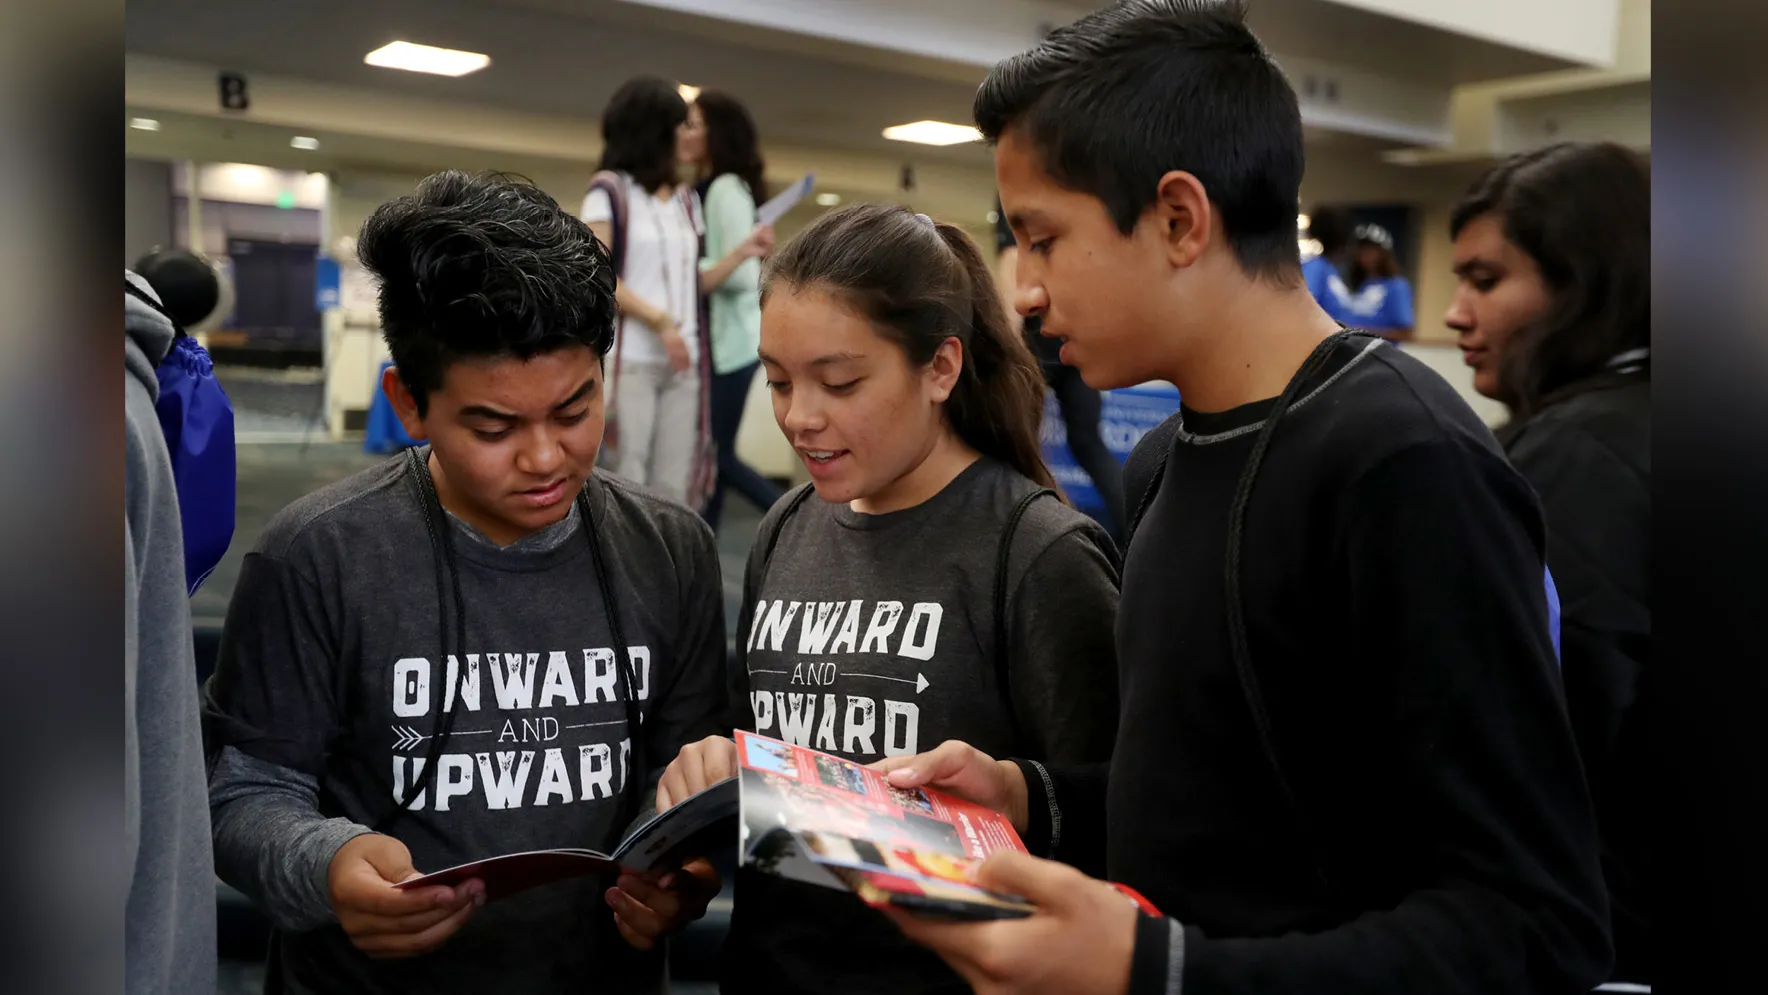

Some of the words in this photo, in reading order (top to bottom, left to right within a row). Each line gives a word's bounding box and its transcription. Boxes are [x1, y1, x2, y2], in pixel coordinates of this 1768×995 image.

[393, 646, 650, 717] ONWARD
[790, 662, 837, 686] AND
[498, 716, 559, 742] AND
[751, 690, 919, 757] PWARD
